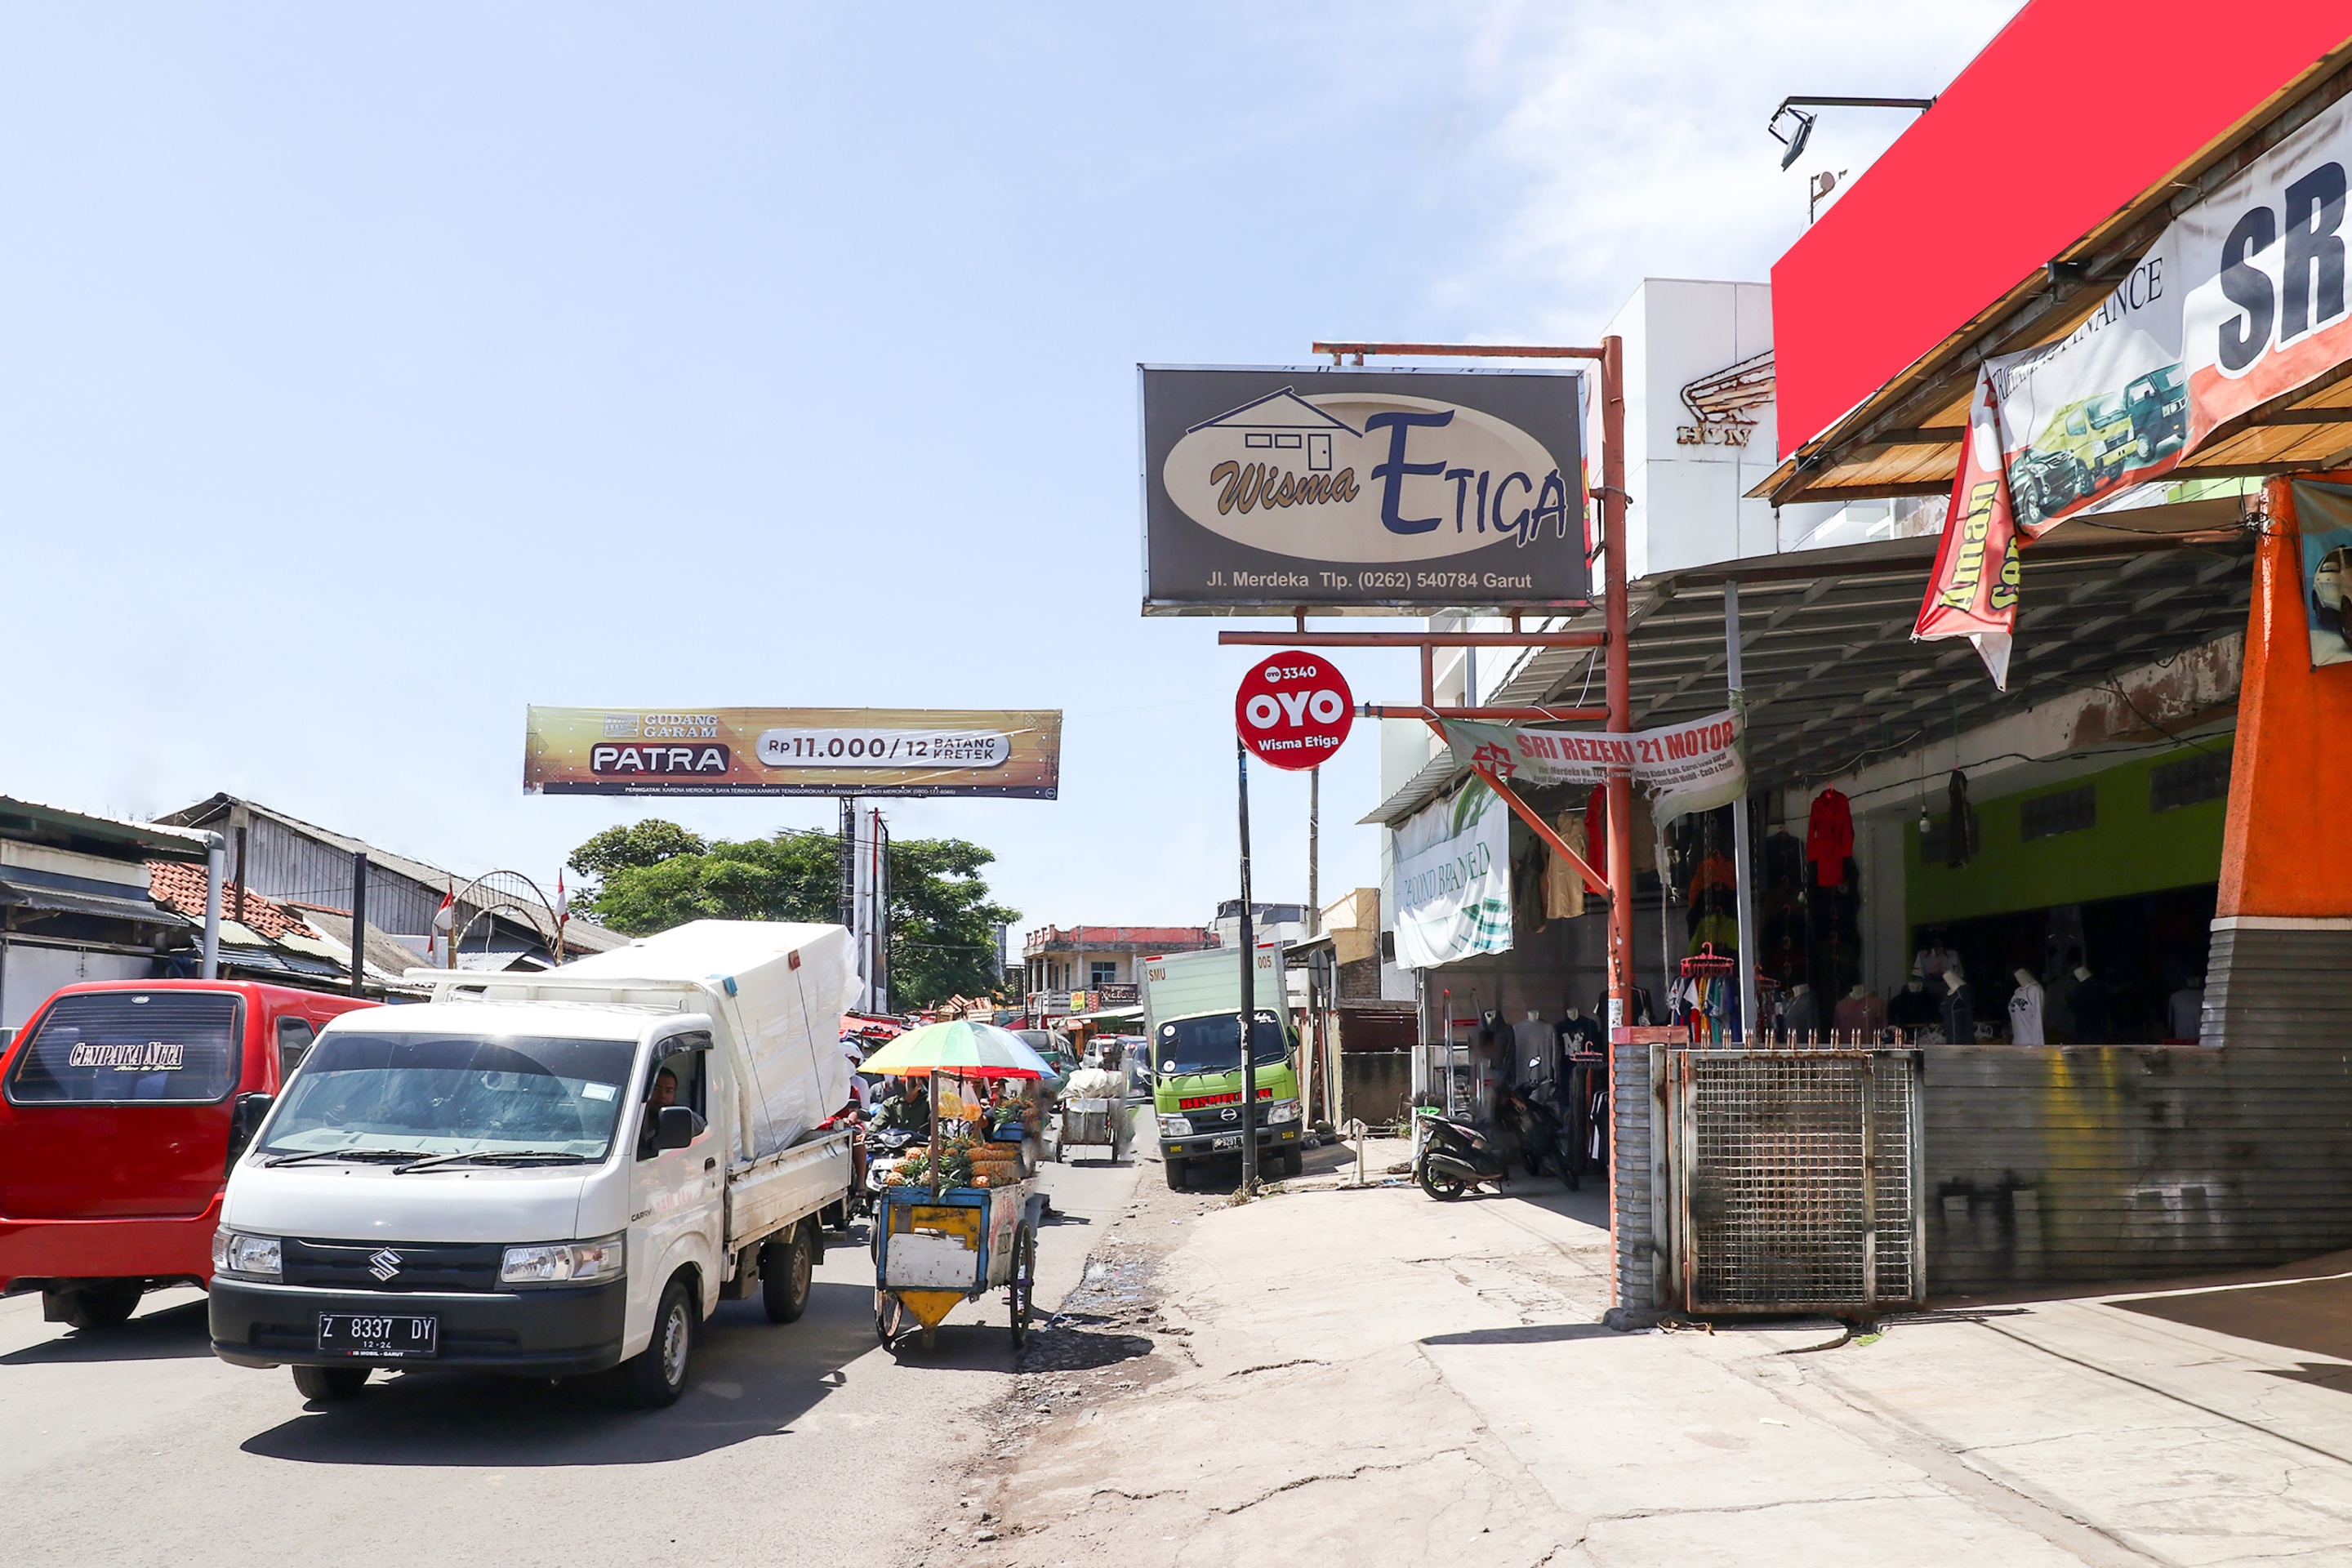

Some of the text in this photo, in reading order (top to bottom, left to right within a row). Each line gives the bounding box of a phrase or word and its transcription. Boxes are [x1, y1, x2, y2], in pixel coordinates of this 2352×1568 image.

[1209, 408, 1568, 547] Wisma ETIGA
[1938, 479, 2000, 613] Aman
[1206, 571, 1532, 591] Jl. Merdeka Tlp. (0262) 540784 Garut
[1282, 666, 1317, 679] 3340
[1245, 688, 1344, 729] OYO
[644, 714, 719, 726] GUDANG
[644, 726, 718, 738] GARAM
[1516, 719, 1735, 764] SRI REZEKI 21 MOTOR
[933, 737, 996, 749] BATANG
[1258, 735, 1339, 751] Wisma Etiga
[594, 746, 727, 772] PATRA
[933, 749, 994, 760] KRETEK
[1148, 956, 1272, 982] SMU 005
[1178, 1088, 1273, 1110] BISMILH
[630, 1209, 653, 1222] CARRY
[323, 1317, 432, 1339] Z 8337 DY
